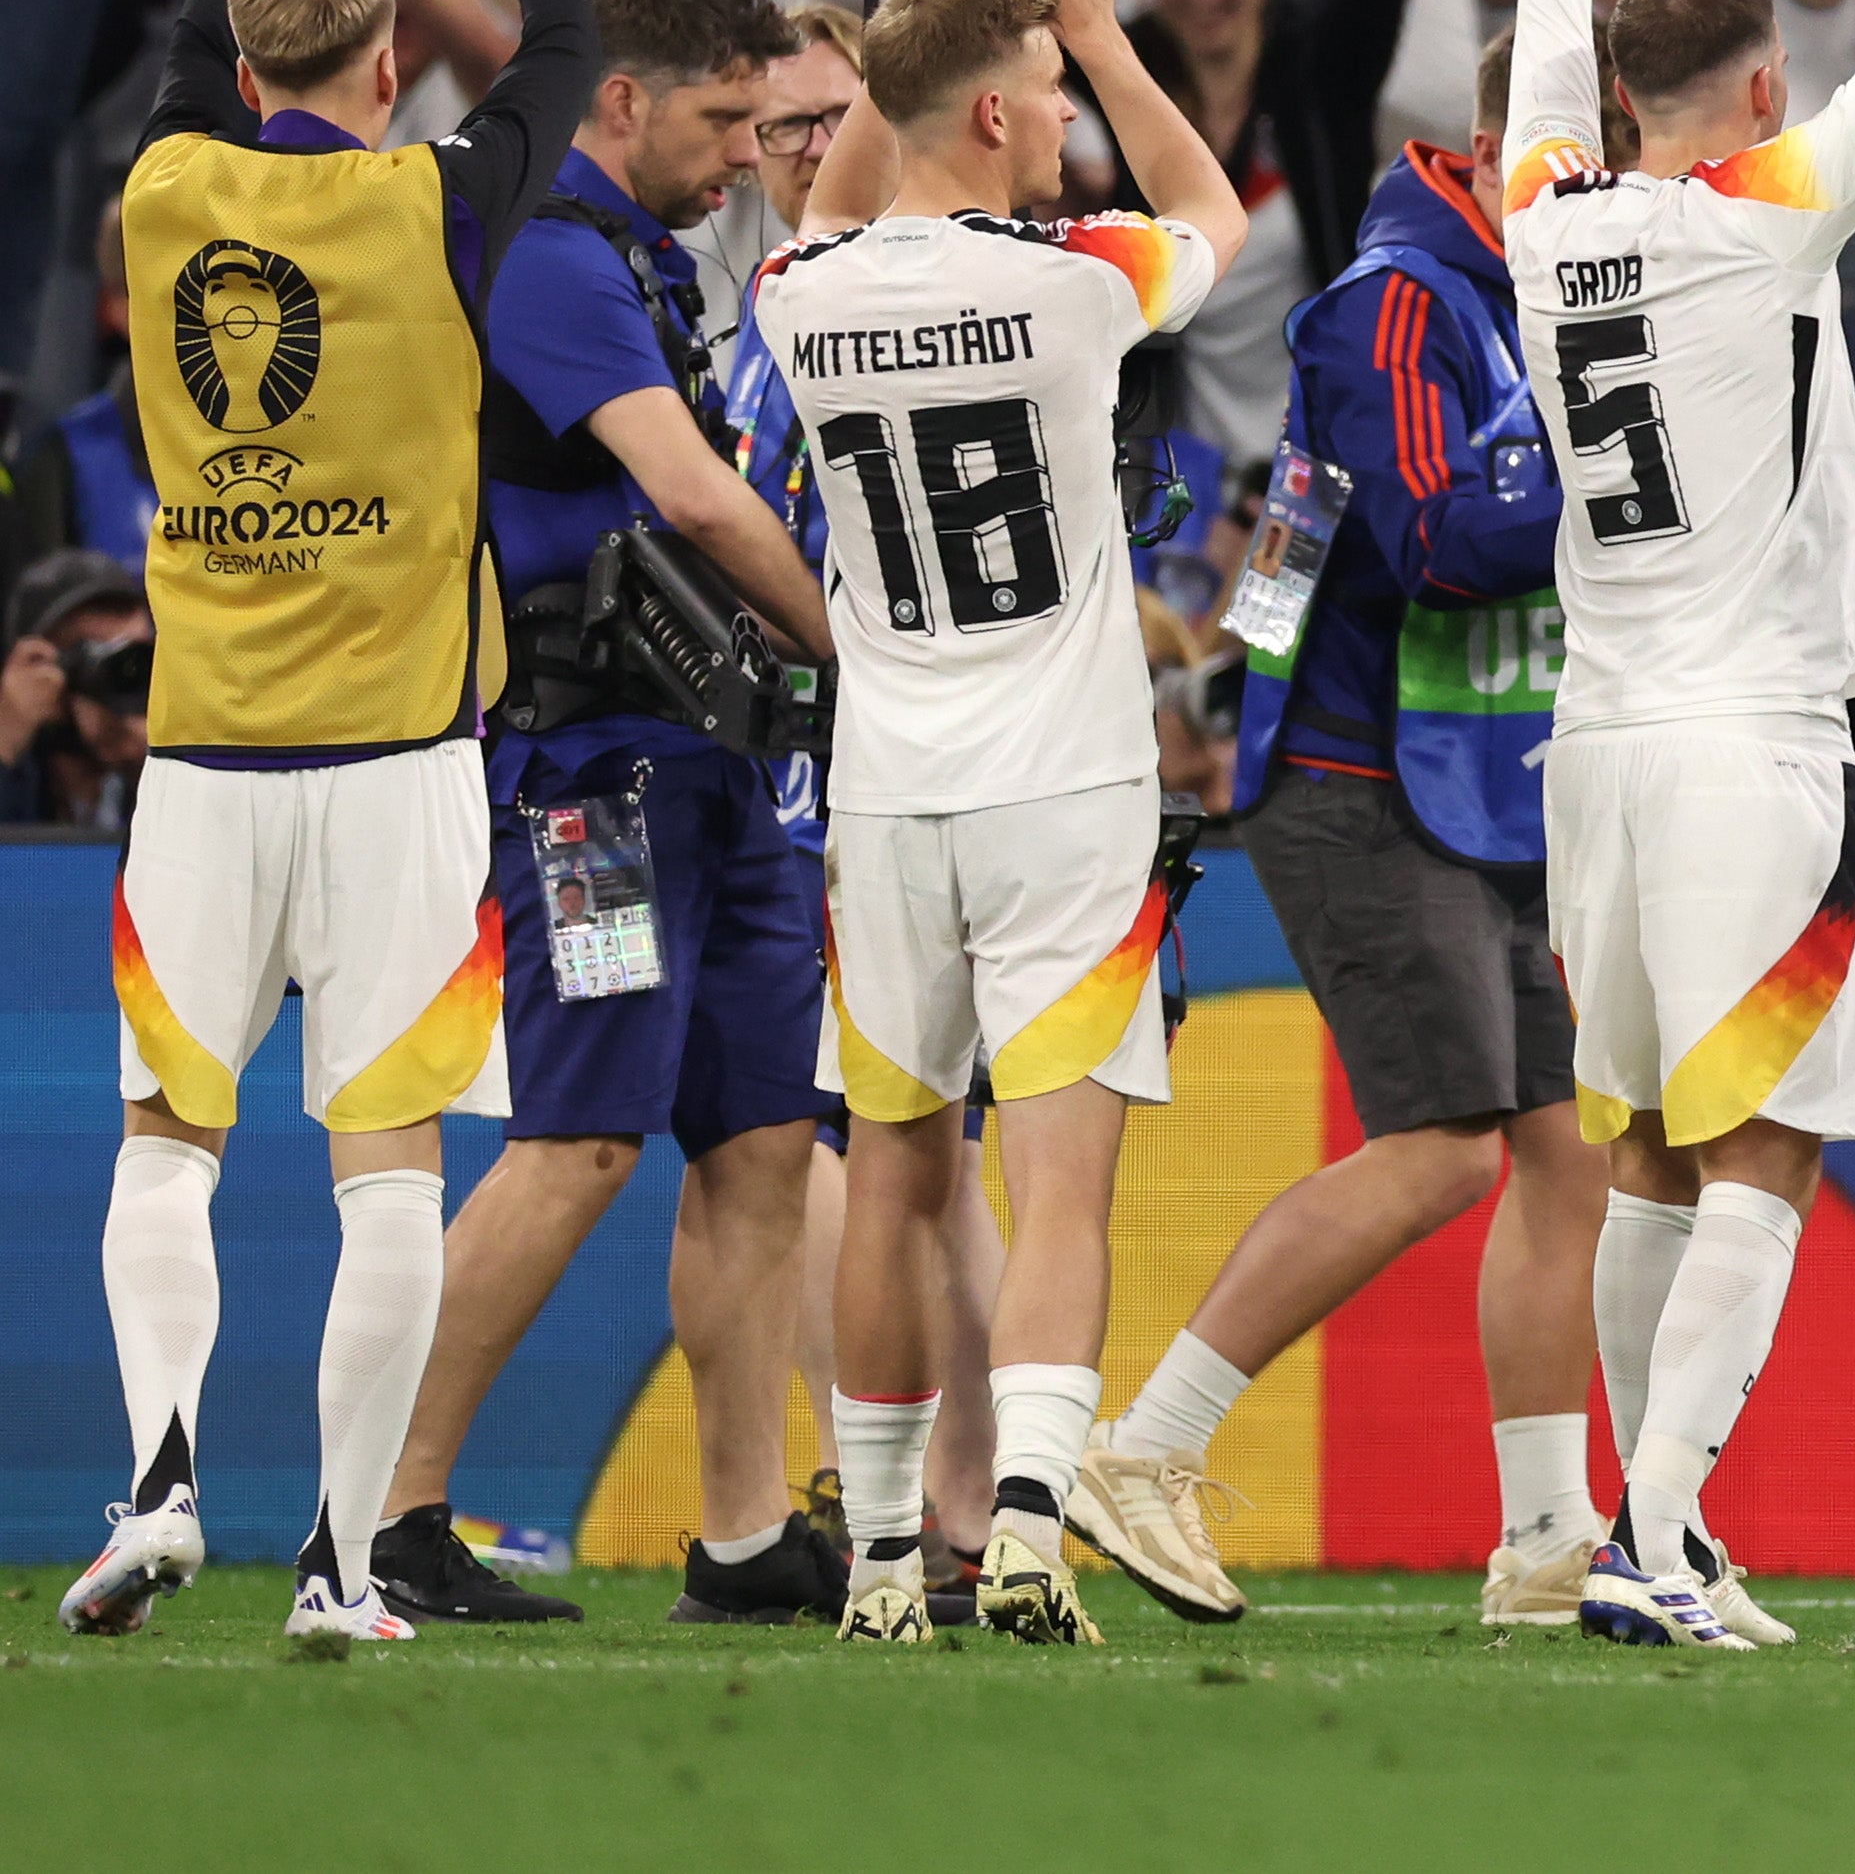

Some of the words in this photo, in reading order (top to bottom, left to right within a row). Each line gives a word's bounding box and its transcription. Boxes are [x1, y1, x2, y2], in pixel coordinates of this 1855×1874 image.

[792, 308, 1035, 379] MITTELSTÄDT
[1556, 314, 1692, 546] 5
[203, 453, 293, 488] UEFA
[162, 497, 390, 546] EURO2024
[817, 397, 1069, 637] 18
[204, 546, 325, 576] GERMANY
